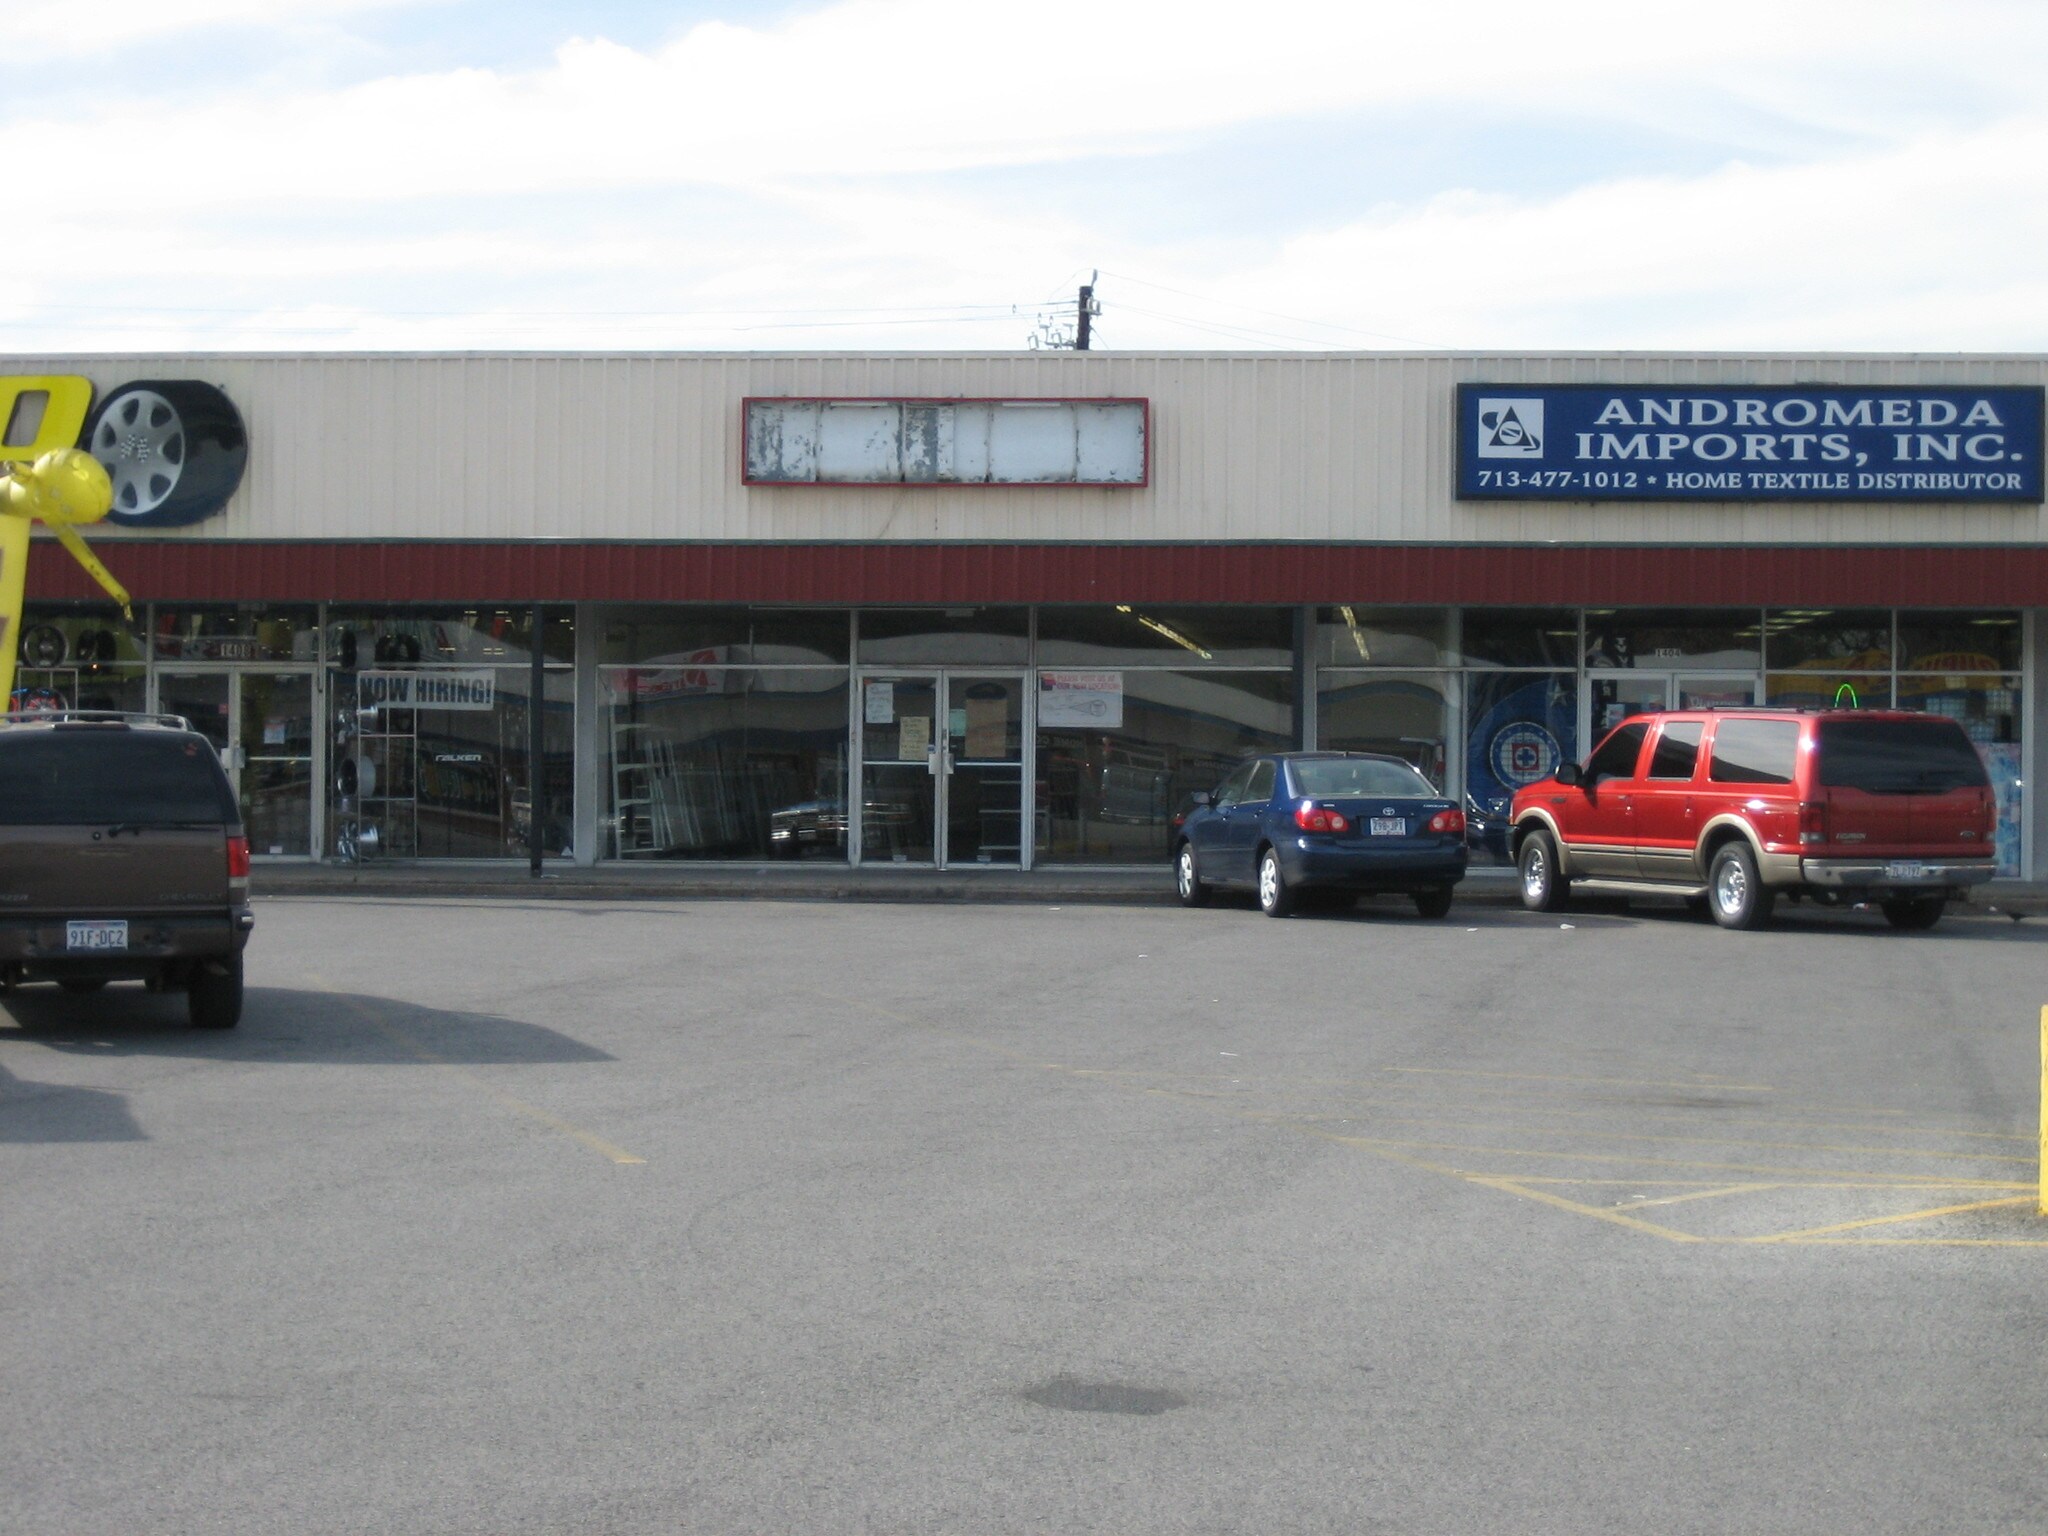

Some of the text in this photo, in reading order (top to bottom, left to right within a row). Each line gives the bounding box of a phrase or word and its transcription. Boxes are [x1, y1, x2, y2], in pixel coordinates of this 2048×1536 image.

[1594, 399, 2003, 427] ANDROMEDA
[1575, 433, 2022, 466] IMPORTS, INC.
[1478, 471, 2021, 489] 713-477-1012 HOME TEXTILE DISTRIBUTOR
[360, 677, 492, 704] NOW HIRING!
